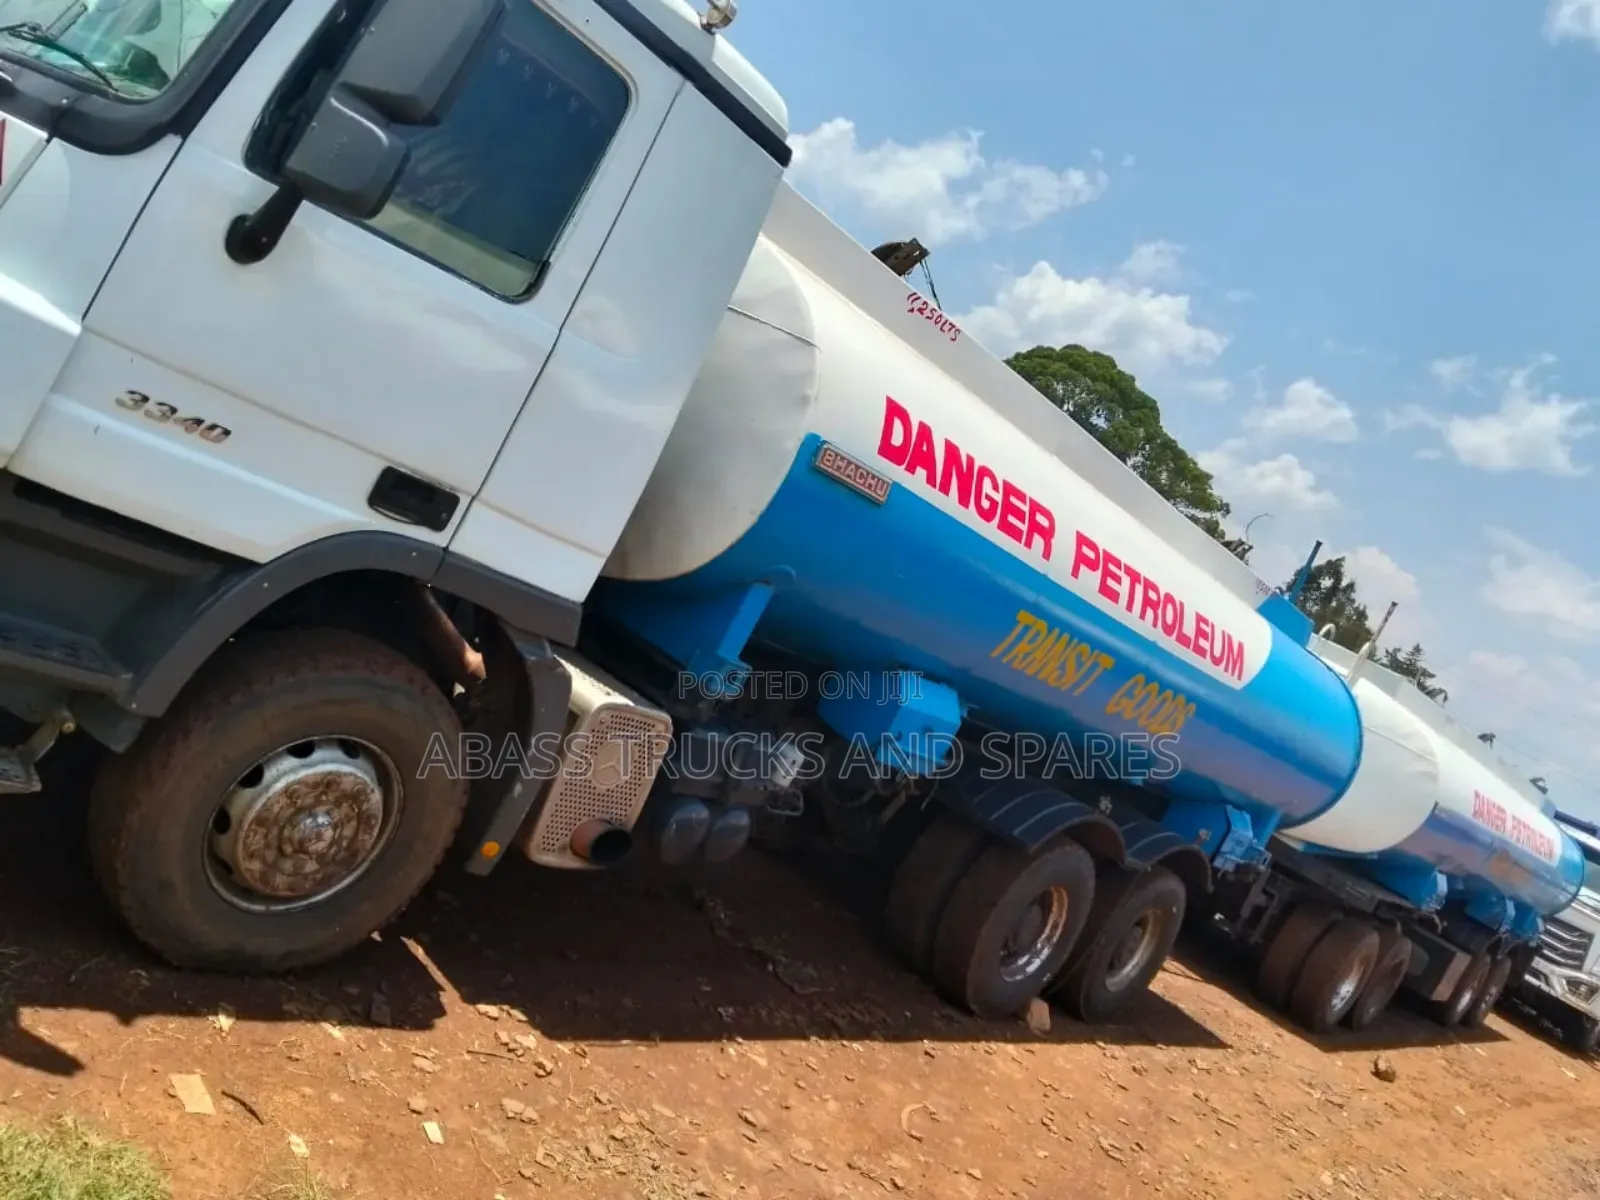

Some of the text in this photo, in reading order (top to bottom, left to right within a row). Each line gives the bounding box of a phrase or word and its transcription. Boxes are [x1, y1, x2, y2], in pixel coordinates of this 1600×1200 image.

[114, 390, 232, 443] 3340
[823, 449, 887, 497] BHACHU
[877, 396, 1245, 682] DANGER PETROLEUM
[990, 609, 1196, 734] TRANSIT GOODS
